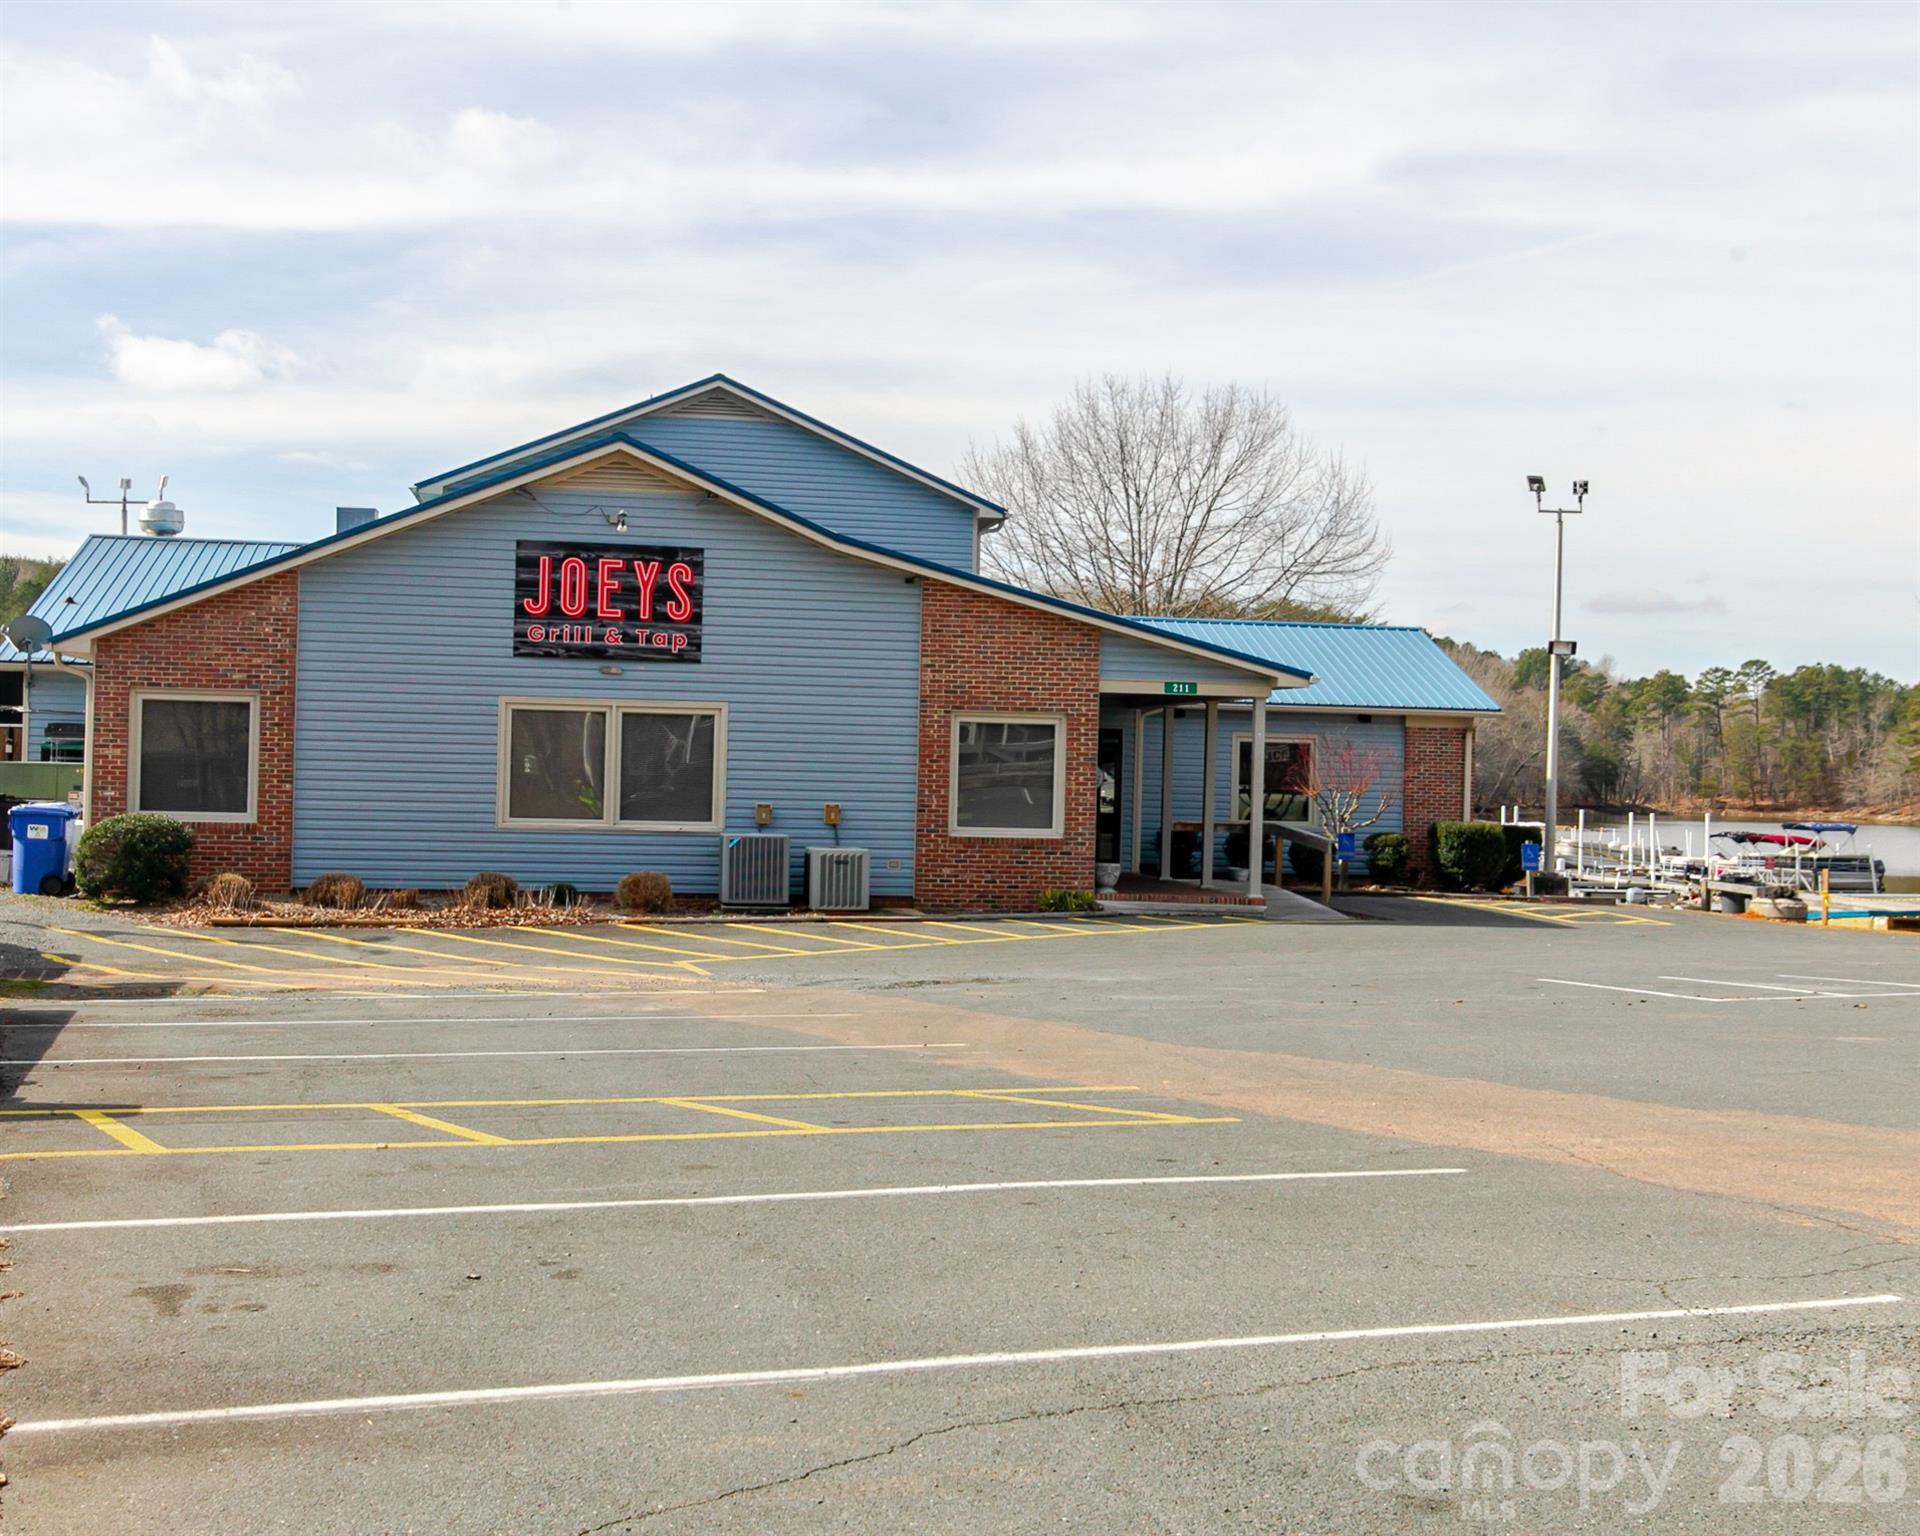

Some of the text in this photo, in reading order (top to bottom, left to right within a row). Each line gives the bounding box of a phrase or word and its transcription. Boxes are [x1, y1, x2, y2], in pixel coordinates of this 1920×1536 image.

[523, 555, 695, 623] JOEYS
[527, 624, 688, 653] Grill & Tap
[1172, 683, 1189, 693] 211
